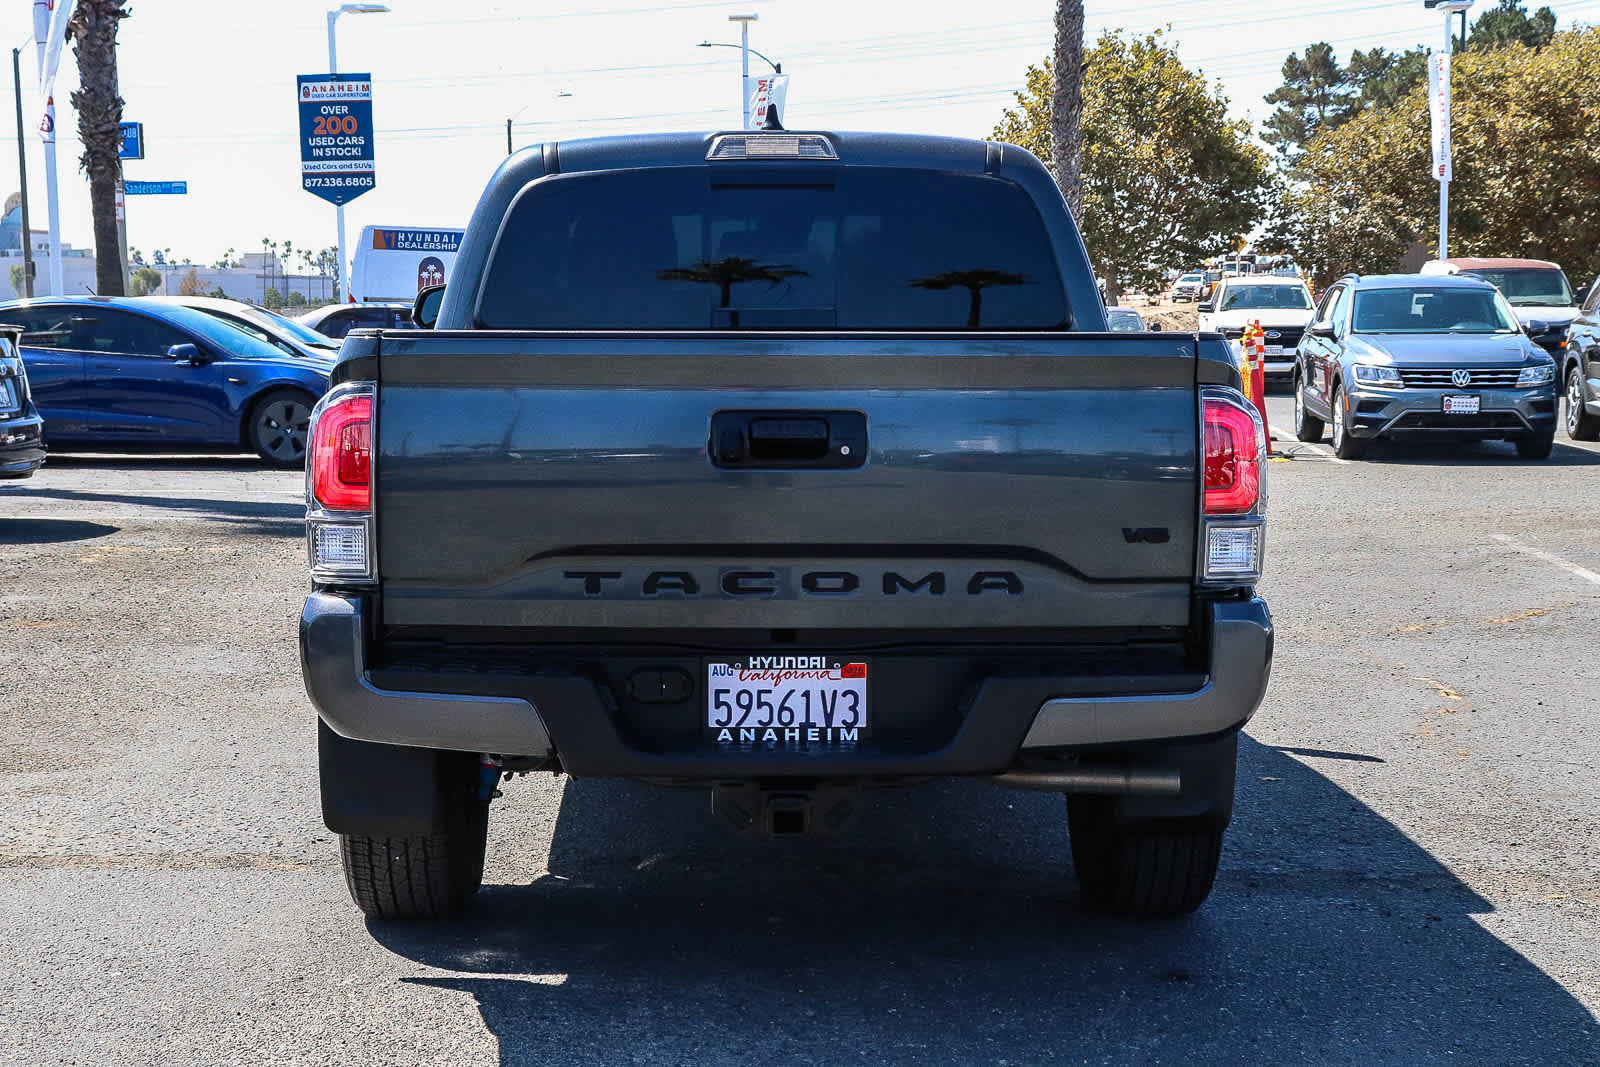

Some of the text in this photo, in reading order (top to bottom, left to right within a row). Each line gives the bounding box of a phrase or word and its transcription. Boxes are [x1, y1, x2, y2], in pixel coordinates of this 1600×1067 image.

[312, 84, 370, 93] ANAHEIM
[321, 105, 349, 115] OVER
[313, 116, 358, 135] 200
[308, 136, 365, 146] USED CARS
[312, 147, 362, 157] IN STOCK!
[304, 177, 373, 187] 877.336.6805
[124, 183, 162, 194] Sanderson
[398, 232, 455, 243] HYUNDAI
[397, 241, 458, 250] DEALERSHIP
[563, 571, 1024, 595] TACOMA
[750, 656, 826, 669] HYUNDAI
[712, 665, 734, 677] AUG
[739, 669, 842, 687] California
[714, 689, 860, 728] 59561V3
[717, 728, 858, 741] ANAHEIM
